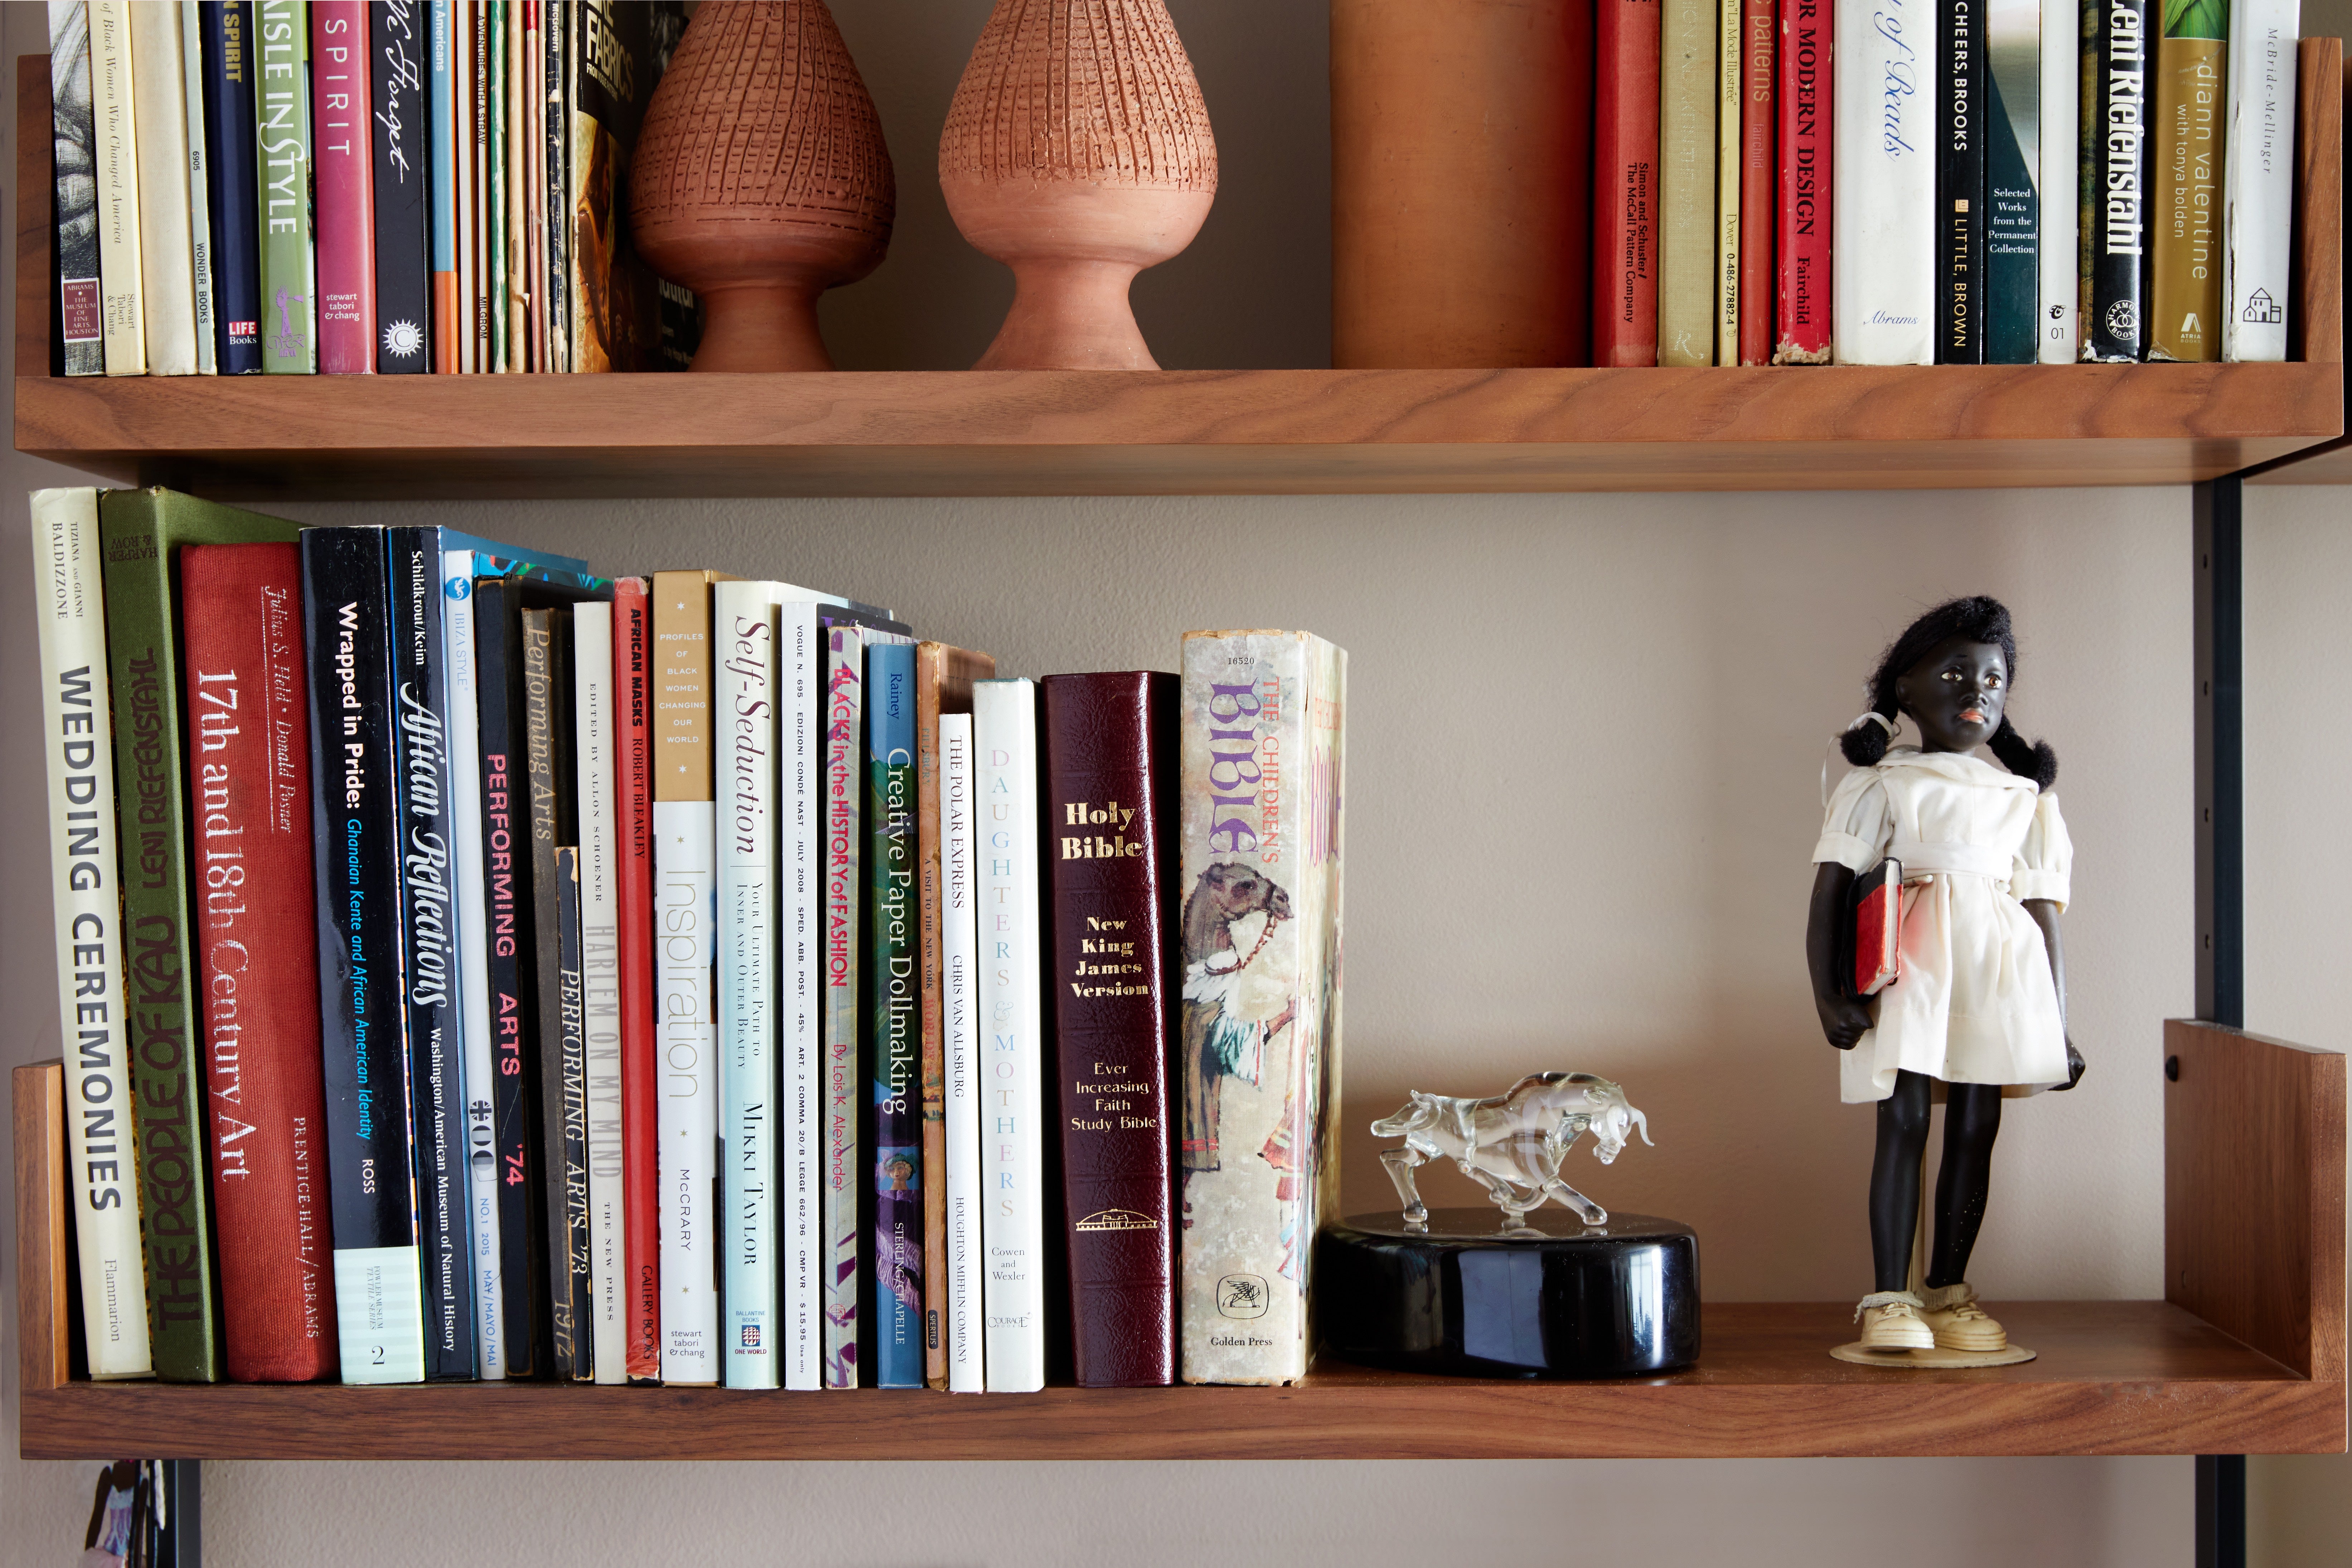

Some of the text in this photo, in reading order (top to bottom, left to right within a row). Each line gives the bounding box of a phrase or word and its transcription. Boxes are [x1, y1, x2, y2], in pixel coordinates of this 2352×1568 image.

[224, 14, 241, 83] SPIRIT
[435, 10, 446, 72] Americans
[587, 9, 633, 102] FABRICS
[1750, 15, 1774, 102] patterns
[100, 3, 122, 243] of Black Women Who Changed America
[325, 19, 350, 155] SPIRIT
[1874, 12, 1916, 162] of Beads
[1954, 79, 1967, 150] BROOKS
[2260, 30, 2278, 174] McBride-Mellinger
[192, 149, 202, 171] 6905
[1639, 163, 1648, 198] Simon
[1795, 28, 1816, 325] MODERN DESIGN Fairchild
[1994, 188, 2031, 198] Selected
[2106, 68, 2145, 255] Riefenstahl
[2173, 104, 2189, 237] with tonya bolden
[2192, 64, 2218, 280] diann valentine
[1623, 163, 1637, 323] The McCall Pattern Company
[1639, 201, 1648, 221] and
[1988, 230, 2036, 239] Permanent
[1993, 216, 2032, 226] from the
[1997, 202, 2027, 212] Works
[197, 243, 208, 324] WONDER BOOKS
[1726, 214, 1737, 325] Dover 0-486-27882-4
[1954, 219, 1968, 346] LITTLE, BROWN
[1989, 244, 2035, 253] Collection
[107, 305, 116, 335] Chang
[117, 294, 126, 325] Tabori
[127, 294, 137, 329] Stewart
[229, 323, 256, 335] LIFE
[229, 335, 257, 344] Books
[325, 310, 360, 321] & chang
[478, 295, 488, 339] MILGROM
[1863, 309, 1920, 325] Abrams
[2050, 327, 2064, 340] 01
[52, 523, 68, 619] BALDIZZONE
[412, 551, 426, 665] Schildkrout/Keim
[659, 633, 704, 641] PROFILES
[337, 601, 365, 809] Wrapped in Pride:
[630, 608, 645, 858] AFRICAN MASKS ROBERT BLEAKLEY
[659, 701, 706, 710] CHANGING
[890, 673, 902, 720] Rainey
[1263, 677, 1279, 722] THE
[591, 746, 598, 762] BY
[725, 615, 771, 855] Self-Seduction
[400, 681, 453, 1008] African Reflections
[830, 668, 851, 988] BLACKS in the HISTORY of FASHION
[950, 735, 964, 908] THE POLAR EXPRESS
[1061, 836, 1143, 859] Bible
[1065, 802, 1137, 831] Holy
[60, 666, 121, 1211] WEDDING CEREMONIES
[199, 669, 258, 1182] 17th and 18th Century Art
[488, 755, 521, 1076] PERFORMING ARTS
[882, 748, 912, 1116] Creative Paper Dollmaking
[1082, 939, 1134, 957] King
[1087, 917, 1127, 931] New
[347, 819, 373, 1141] Ghanaian Kente and African American Identity
[659, 870, 708, 1098] Inspiration
[992, 749, 1017, 1217] DAUGHTERS & MOTHERS
[1070, 982, 1150, 997] Version
[1075, 961, 1142, 976] James
[586, 925, 622, 1179] HARLEM ON MY MIND
[362, 1157, 376, 1194] ROSS
[679, 1169, 691, 1251] McCRARY
[105, 1259, 122, 1342] Flammarion
[956, 1197, 966, 1362] HOUGHTON MIFFLIN COMPANY
[1210, 1337, 1273, 1346] Golden Press
